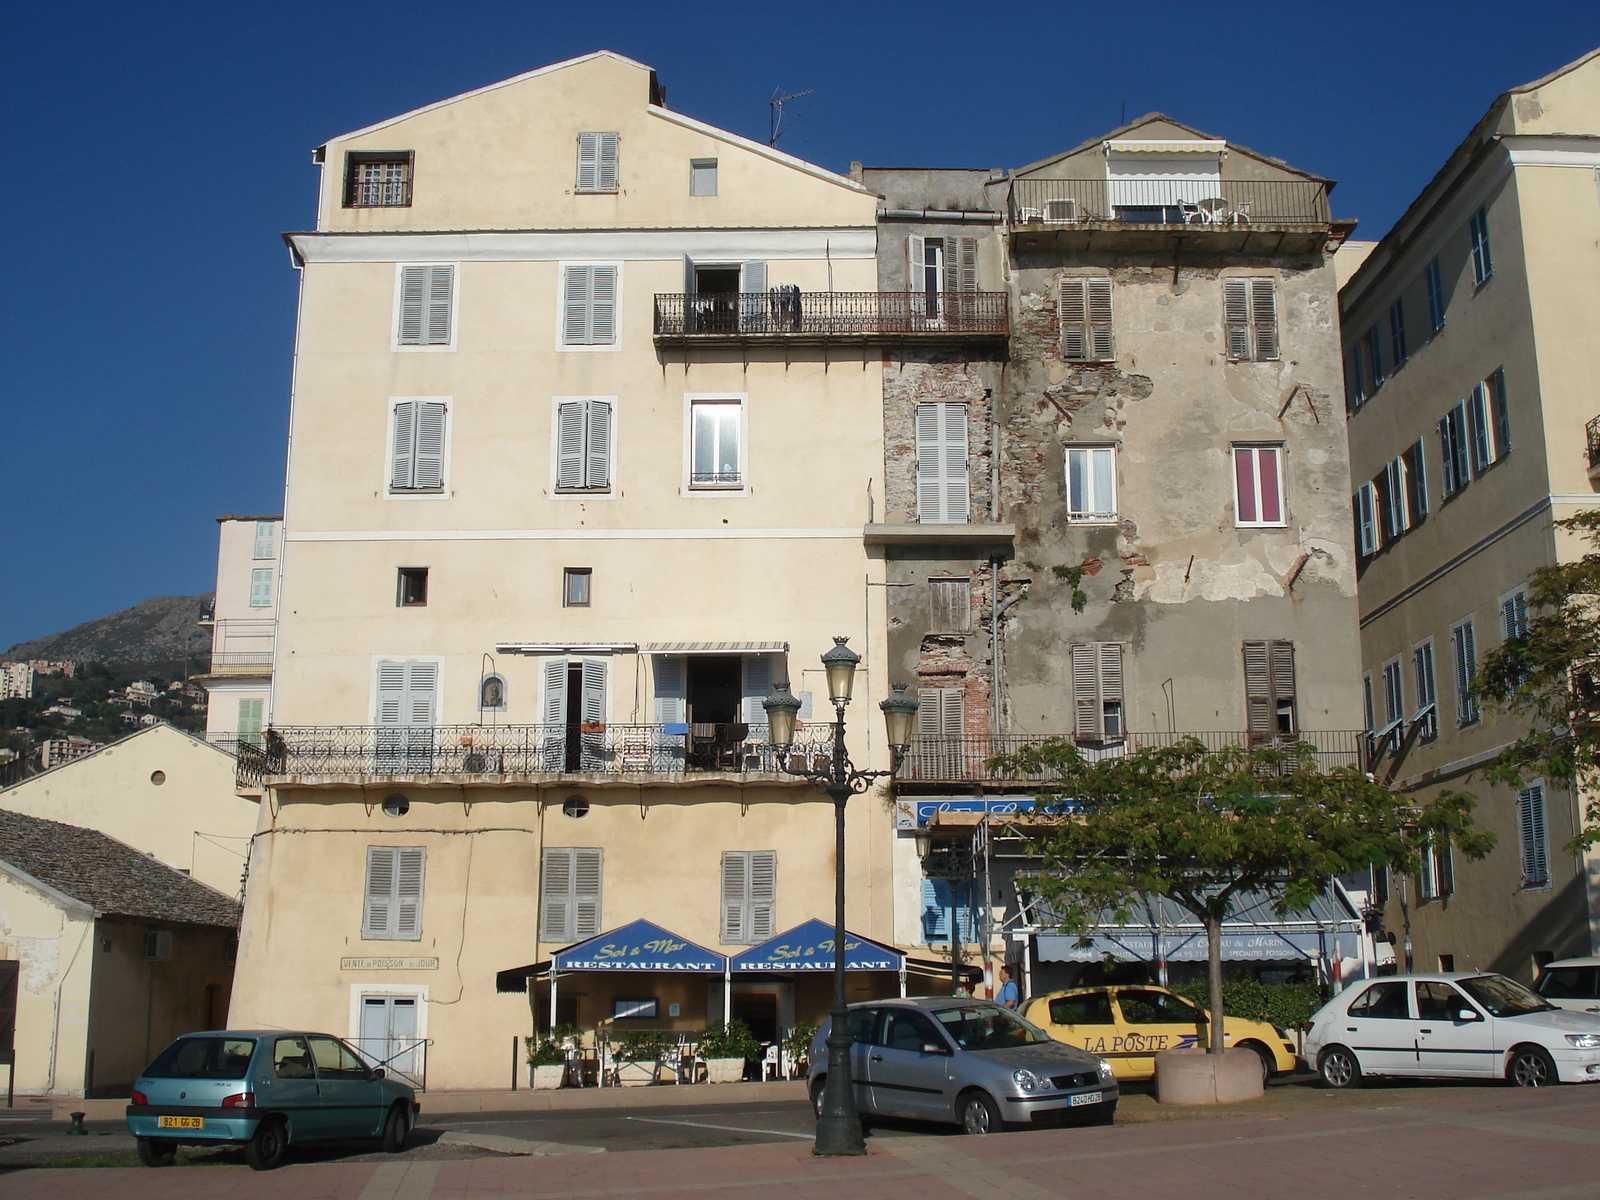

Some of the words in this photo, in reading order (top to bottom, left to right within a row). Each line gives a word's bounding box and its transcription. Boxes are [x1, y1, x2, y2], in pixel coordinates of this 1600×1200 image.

[593, 944, 628, 961] Sol
[629, 946, 641, 956] &
[642, 939, 688, 954] Mar
[1234, 938, 1244, 948] du
[767, 944, 802, 962] Sol
[804, 947, 815, 957] &
[565, 961, 716, 971] RESTAURANT
[1083, 1037, 1107, 1052] LA
[1110, 1034, 1169, 1052] POSTE
